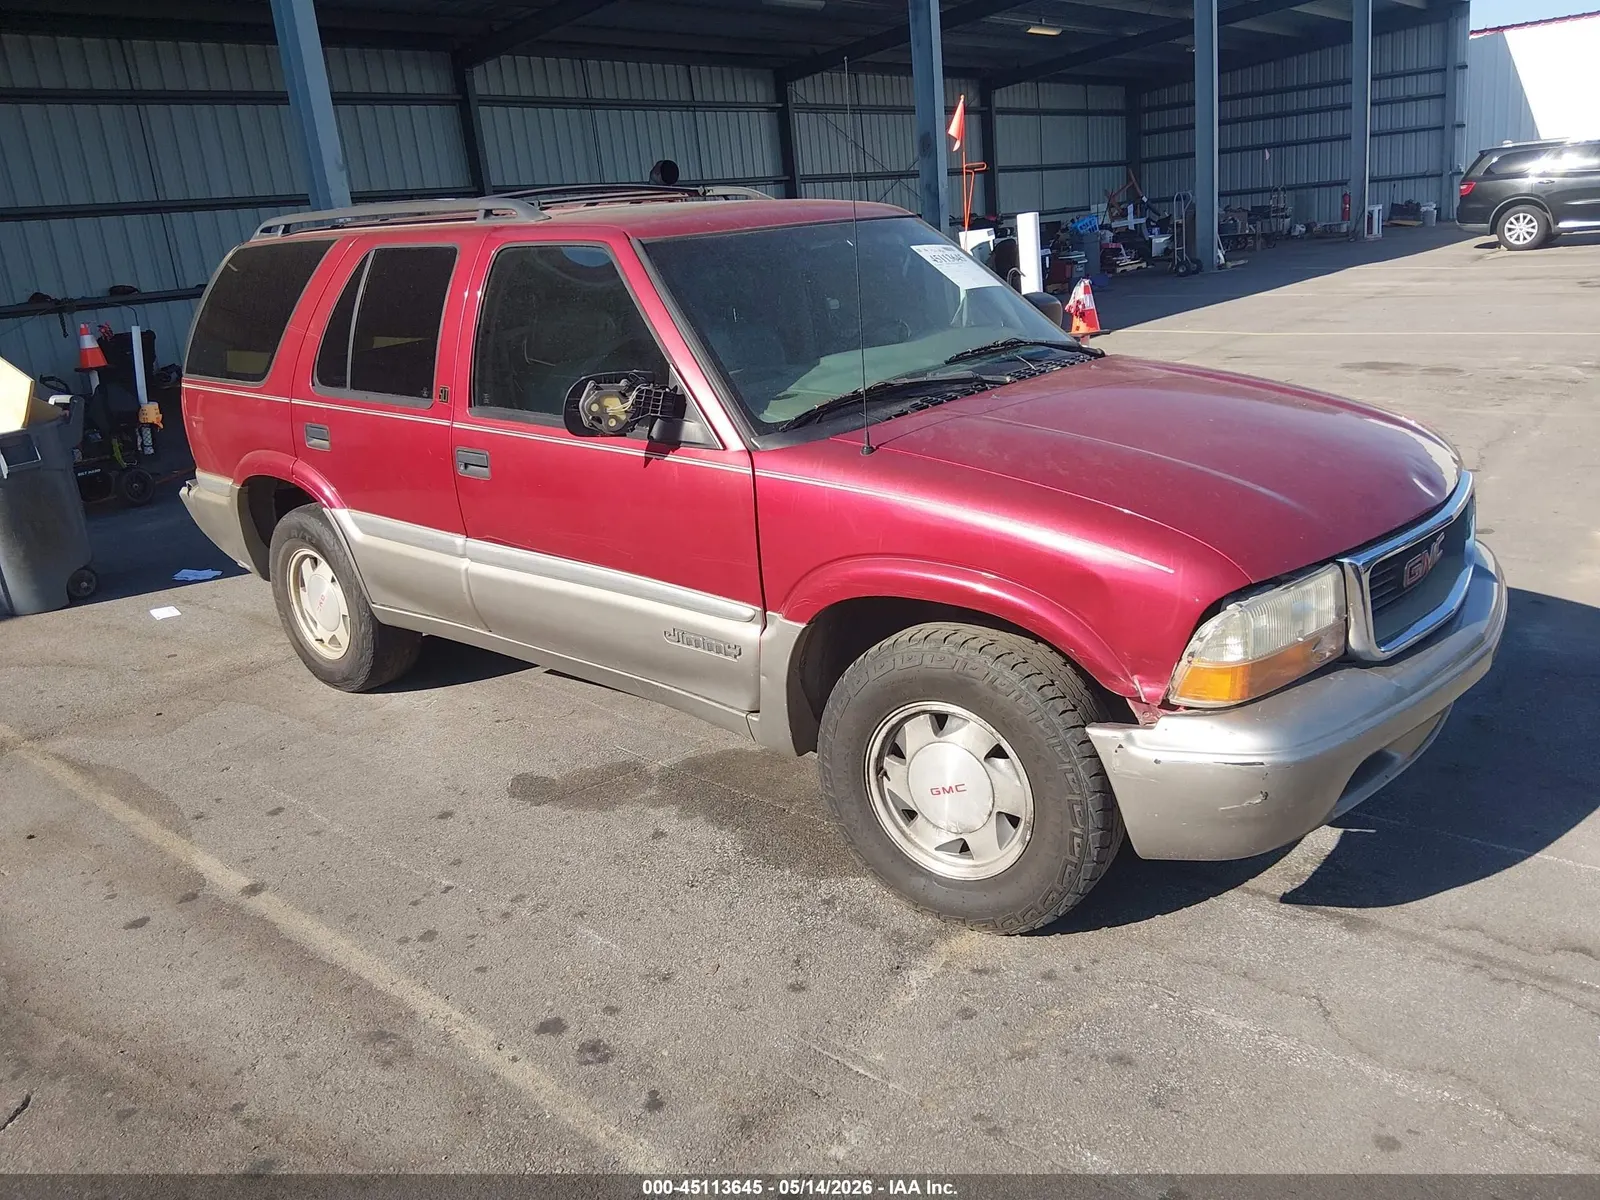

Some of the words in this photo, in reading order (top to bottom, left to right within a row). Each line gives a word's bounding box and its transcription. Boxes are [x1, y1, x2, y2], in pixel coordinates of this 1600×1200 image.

[1403, 532, 1445, 588] GMC
[663, 627, 742, 662] Jimmy
[930, 783, 967, 796] GMC
